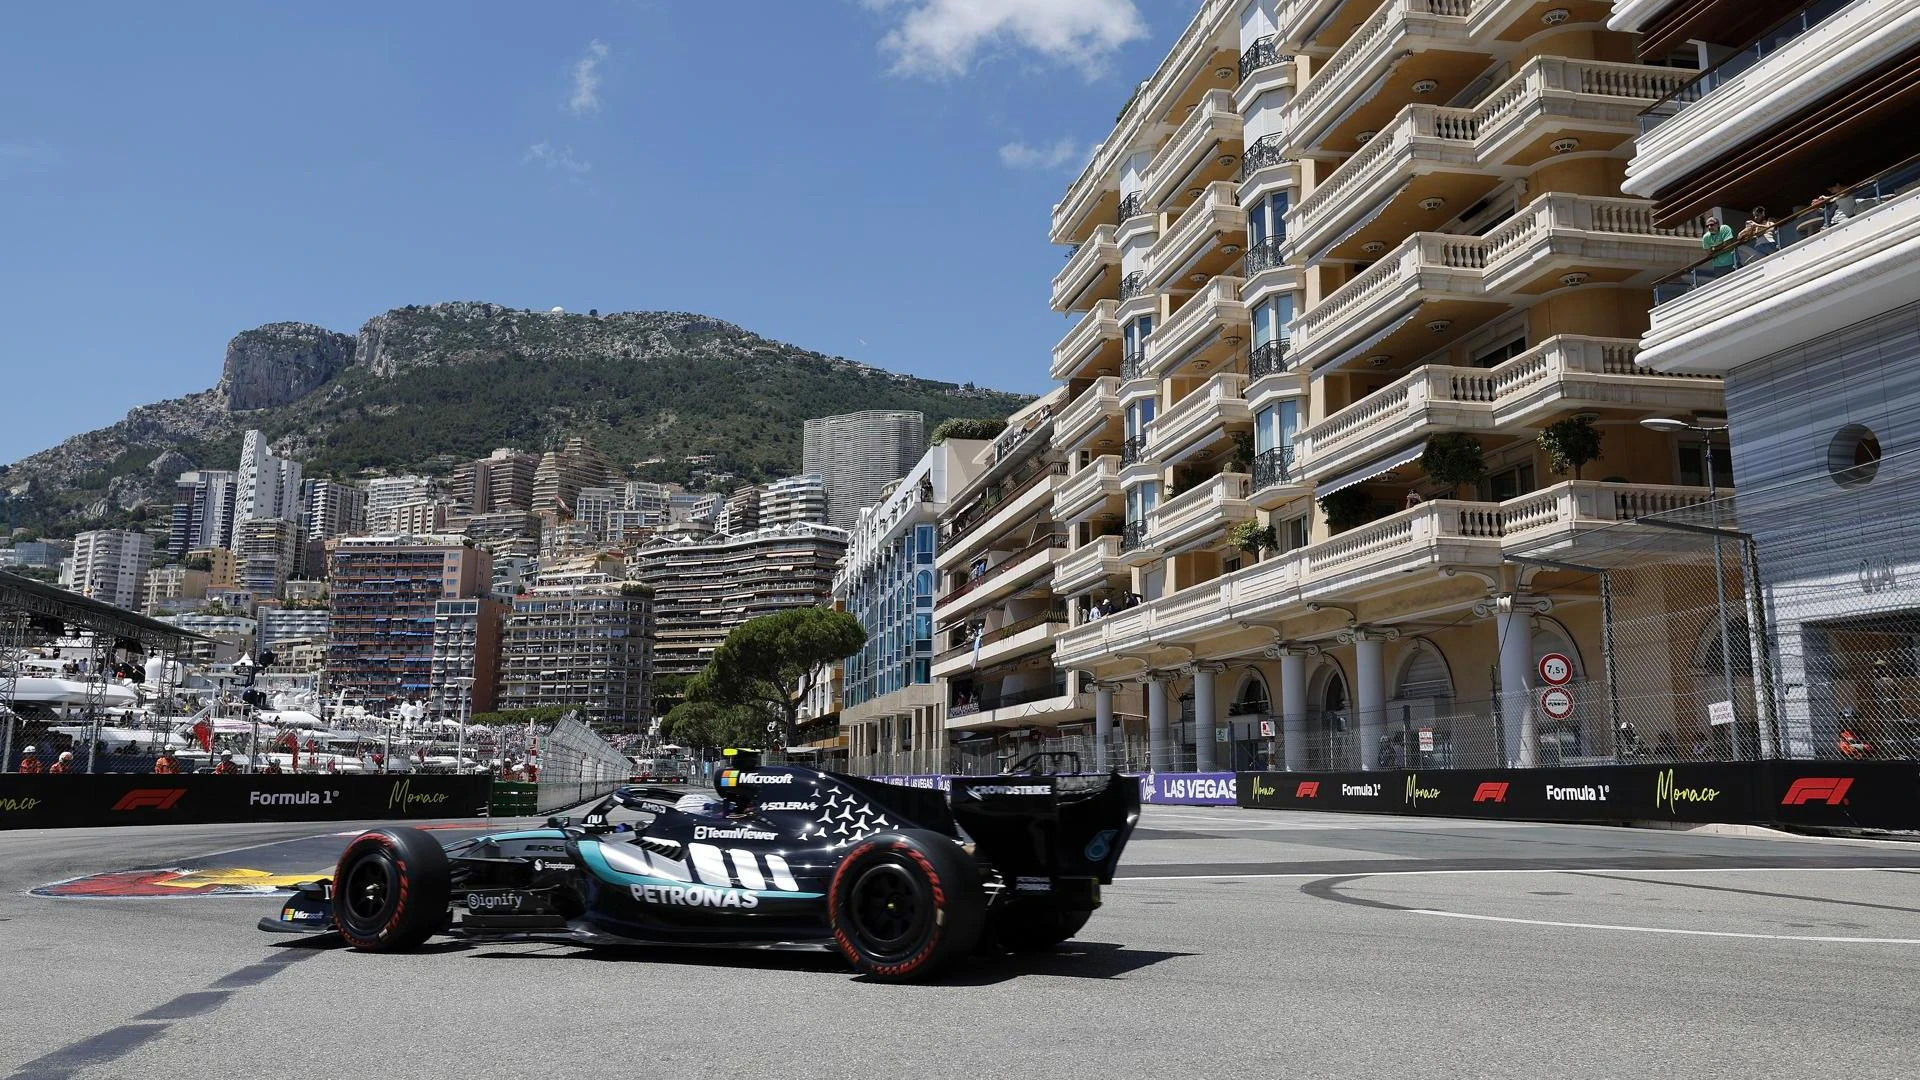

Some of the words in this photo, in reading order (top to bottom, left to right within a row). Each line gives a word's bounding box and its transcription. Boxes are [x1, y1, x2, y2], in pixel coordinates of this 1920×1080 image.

[738, 772, 794, 784] Microsoft
[388, 778, 449, 813] Monaco
[973, 785, 1052, 795] CROWDSTRIKE
[1164, 779, 1185, 798] LAS
[1187, 779, 1237, 799] VEGAS
[1252, 775, 1276, 803] Monaco
[1342, 783, 1373, 796] Formula
[1405, 773, 1441, 809] Monaco
[1546, 784, 1596, 801] Formula
[1656, 768, 1720, 815] Monaco
[250, 790, 320, 805] Formula
[766, 801, 809, 811] SOLERA
[707, 827, 778, 841] TeamViewer
[538, 844, 565, 852] AMG
[544, 861, 576, 871] Snapdragon
[629, 883, 759, 909] PETRONAS
